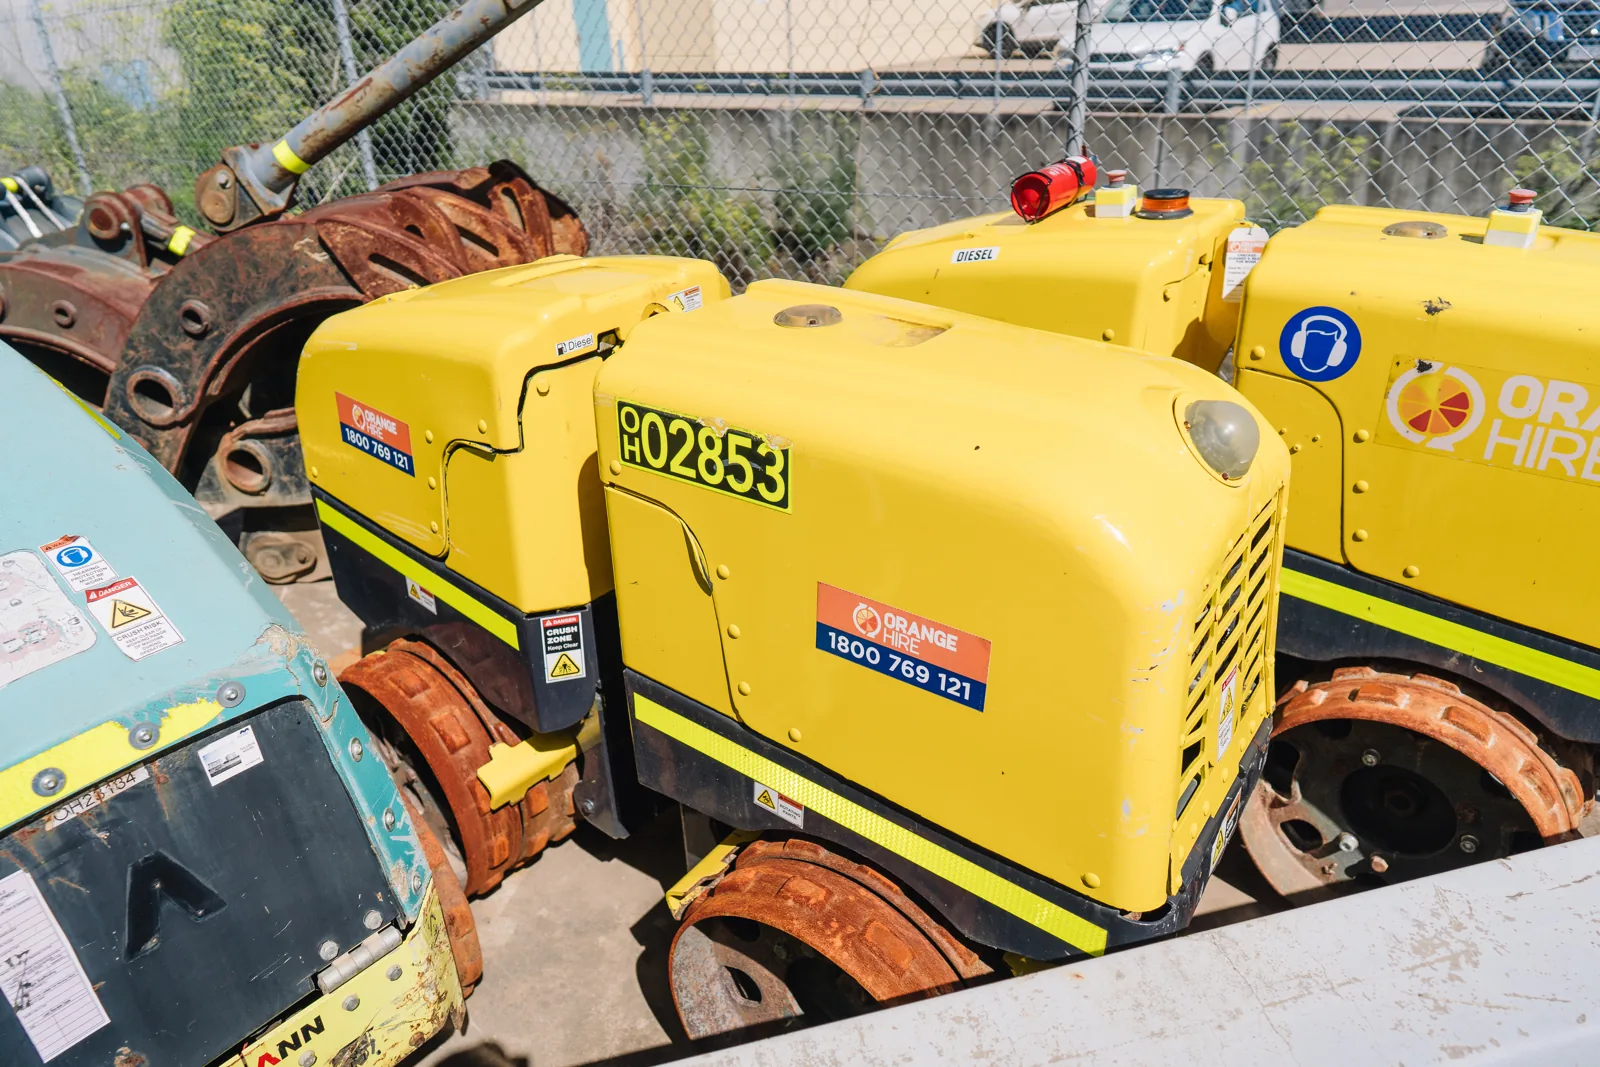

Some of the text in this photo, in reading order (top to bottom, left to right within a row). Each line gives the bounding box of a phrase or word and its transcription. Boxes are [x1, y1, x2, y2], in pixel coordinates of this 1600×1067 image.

[957, 250, 993, 262] DIESEL
[568, 335, 593, 351] Diesel
[364, 409, 398, 436] ORANGE
[366, 422, 384, 440] HIRE
[345, 428, 409, 470] 1800 769 121
[641, 412, 786, 503] 02853
[71, 567, 108, 581] PROTECTION
[72, 565, 100, 576] HEARING
[79, 574, 96, 583] MUST
[85, 577, 103, 585] WORN
[98, 580, 132, 597] DANGER
[553, 617, 577, 625] DANGER
[117, 621, 162, 641] CRUSH RISK
[546, 625, 578, 636] CRUSH
[883, 612, 959, 652] ORANGE
[126, 637, 150, 647] WORKING
[142, 640, 161, 650] DURING
[546, 634, 573, 644] ZONE
[883, 628, 921, 655] HIRE
[140, 642, 168, 655] OPERATION
[828, 631, 971, 700] 1800 769 121
